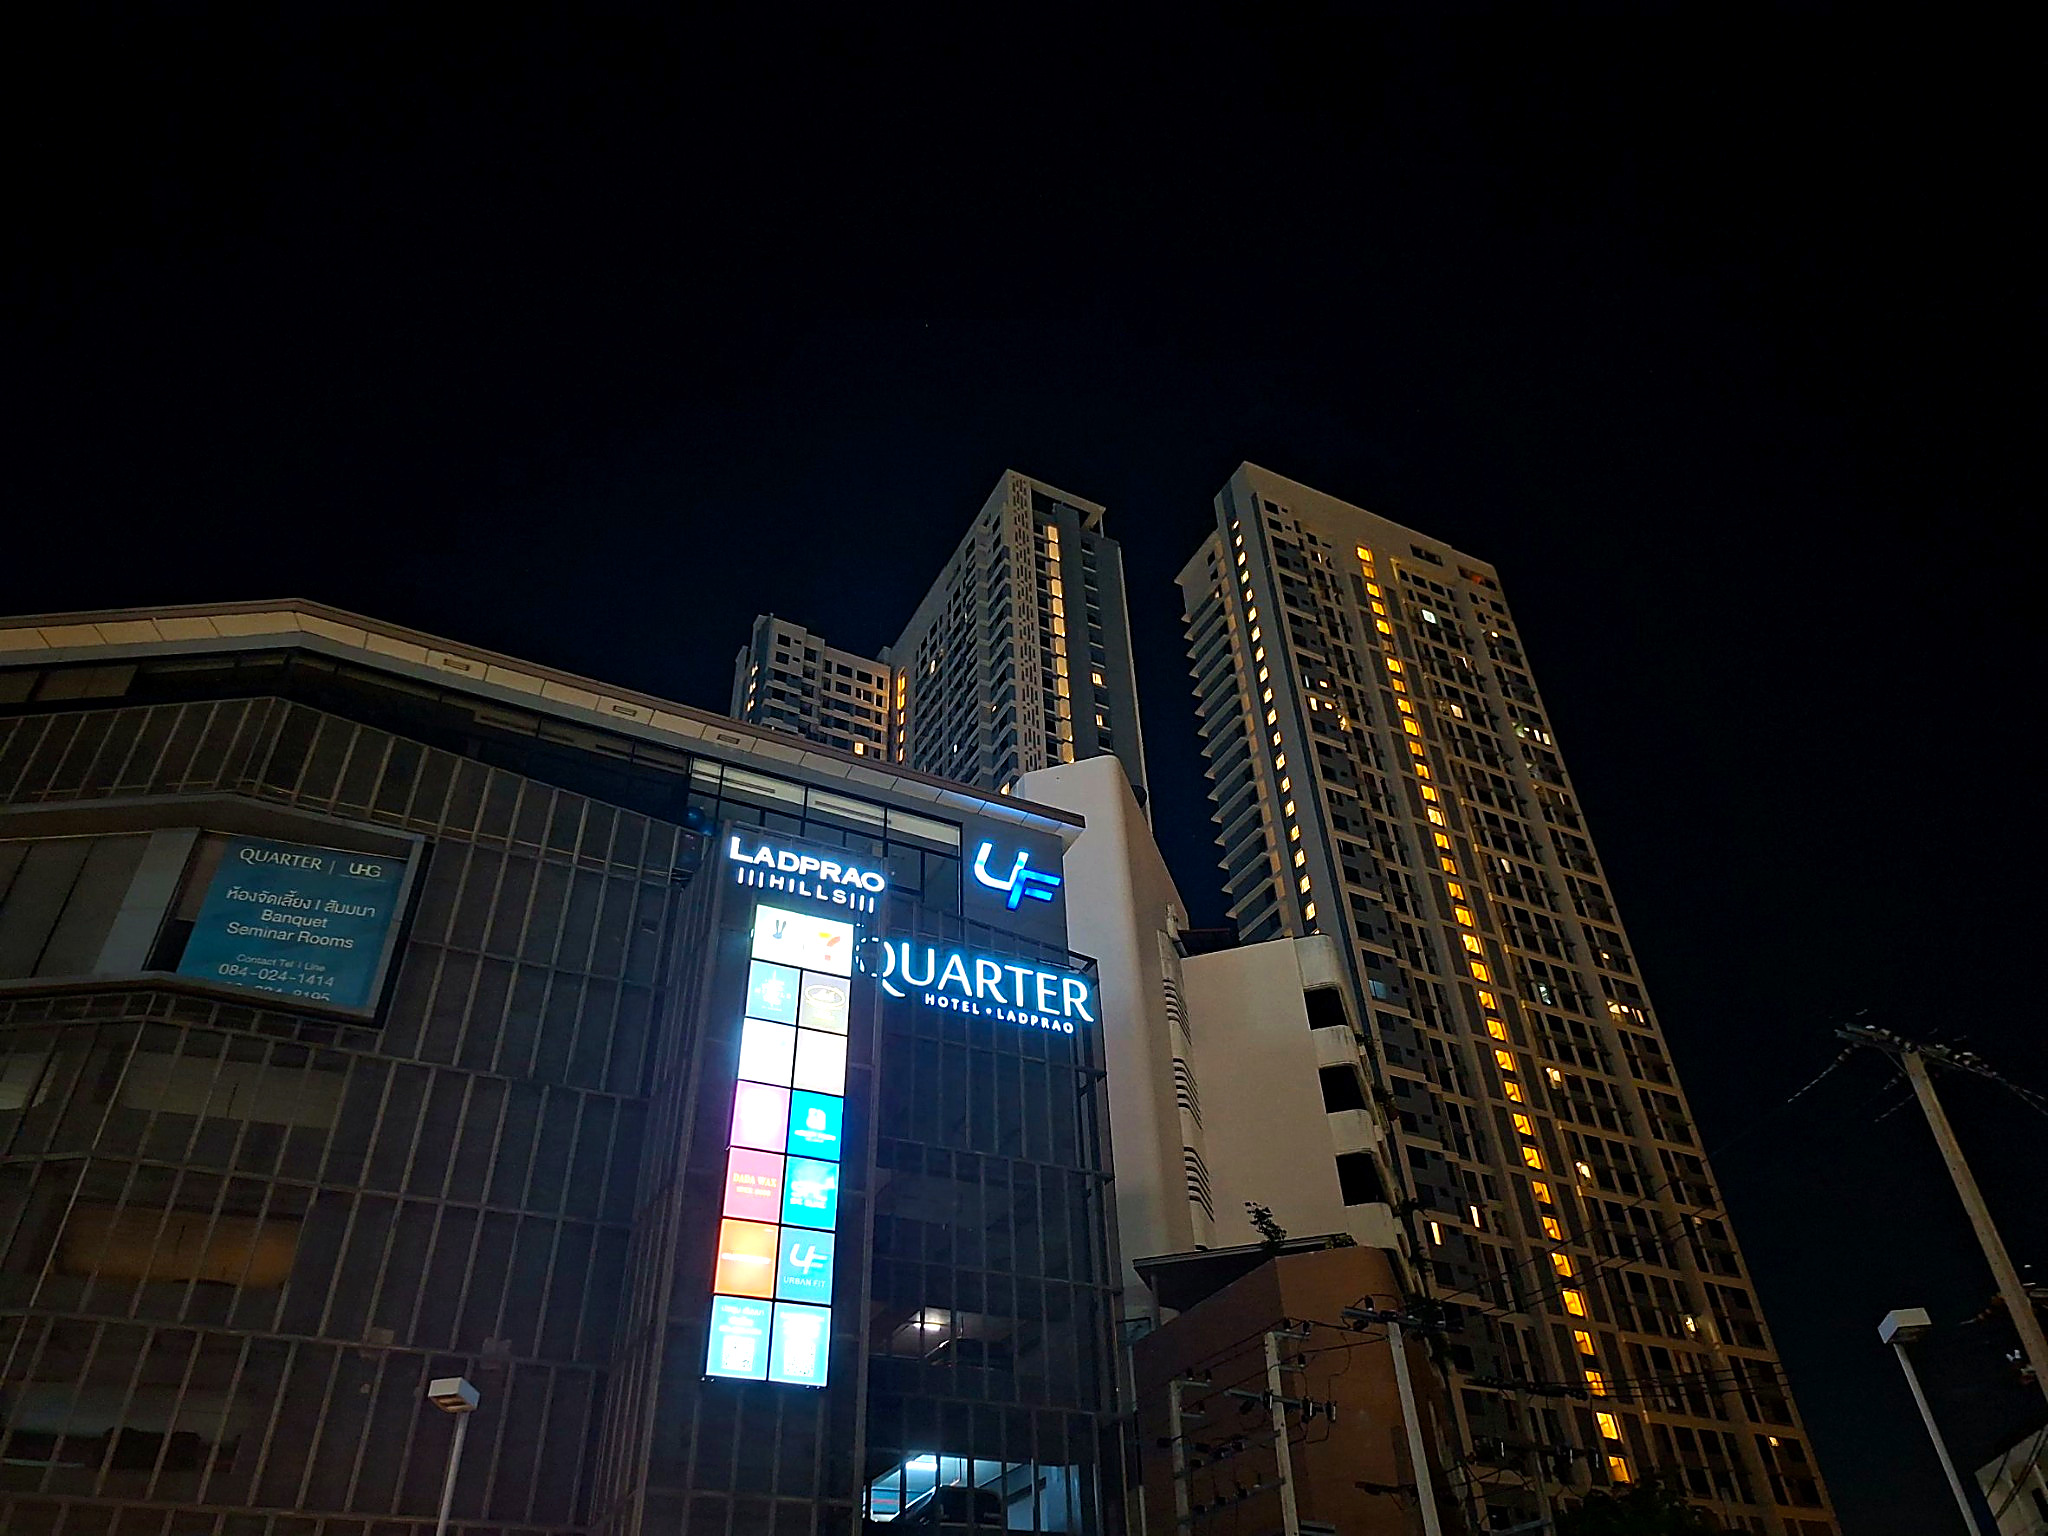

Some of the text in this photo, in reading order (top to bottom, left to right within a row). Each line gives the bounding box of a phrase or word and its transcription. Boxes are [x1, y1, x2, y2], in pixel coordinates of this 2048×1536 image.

[239, 848, 323, 871] QUARTER
[729, 836, 885, 893] LADPRAO
[261, 909, 329, 928] Banquet
[226, 922, 355, 949] Seminar Rooms
[236, 953, 277, 966] Contact
[304, 962, 326, 972] Line
[218, 963, 335, 987] 084-024-1414
[856, 936, 1095, 1023] QUARTER
[924, 992, 1074, 1035] HOTEL LADPRAO
[783, 1275, 826, 1288] URBAN FIT
